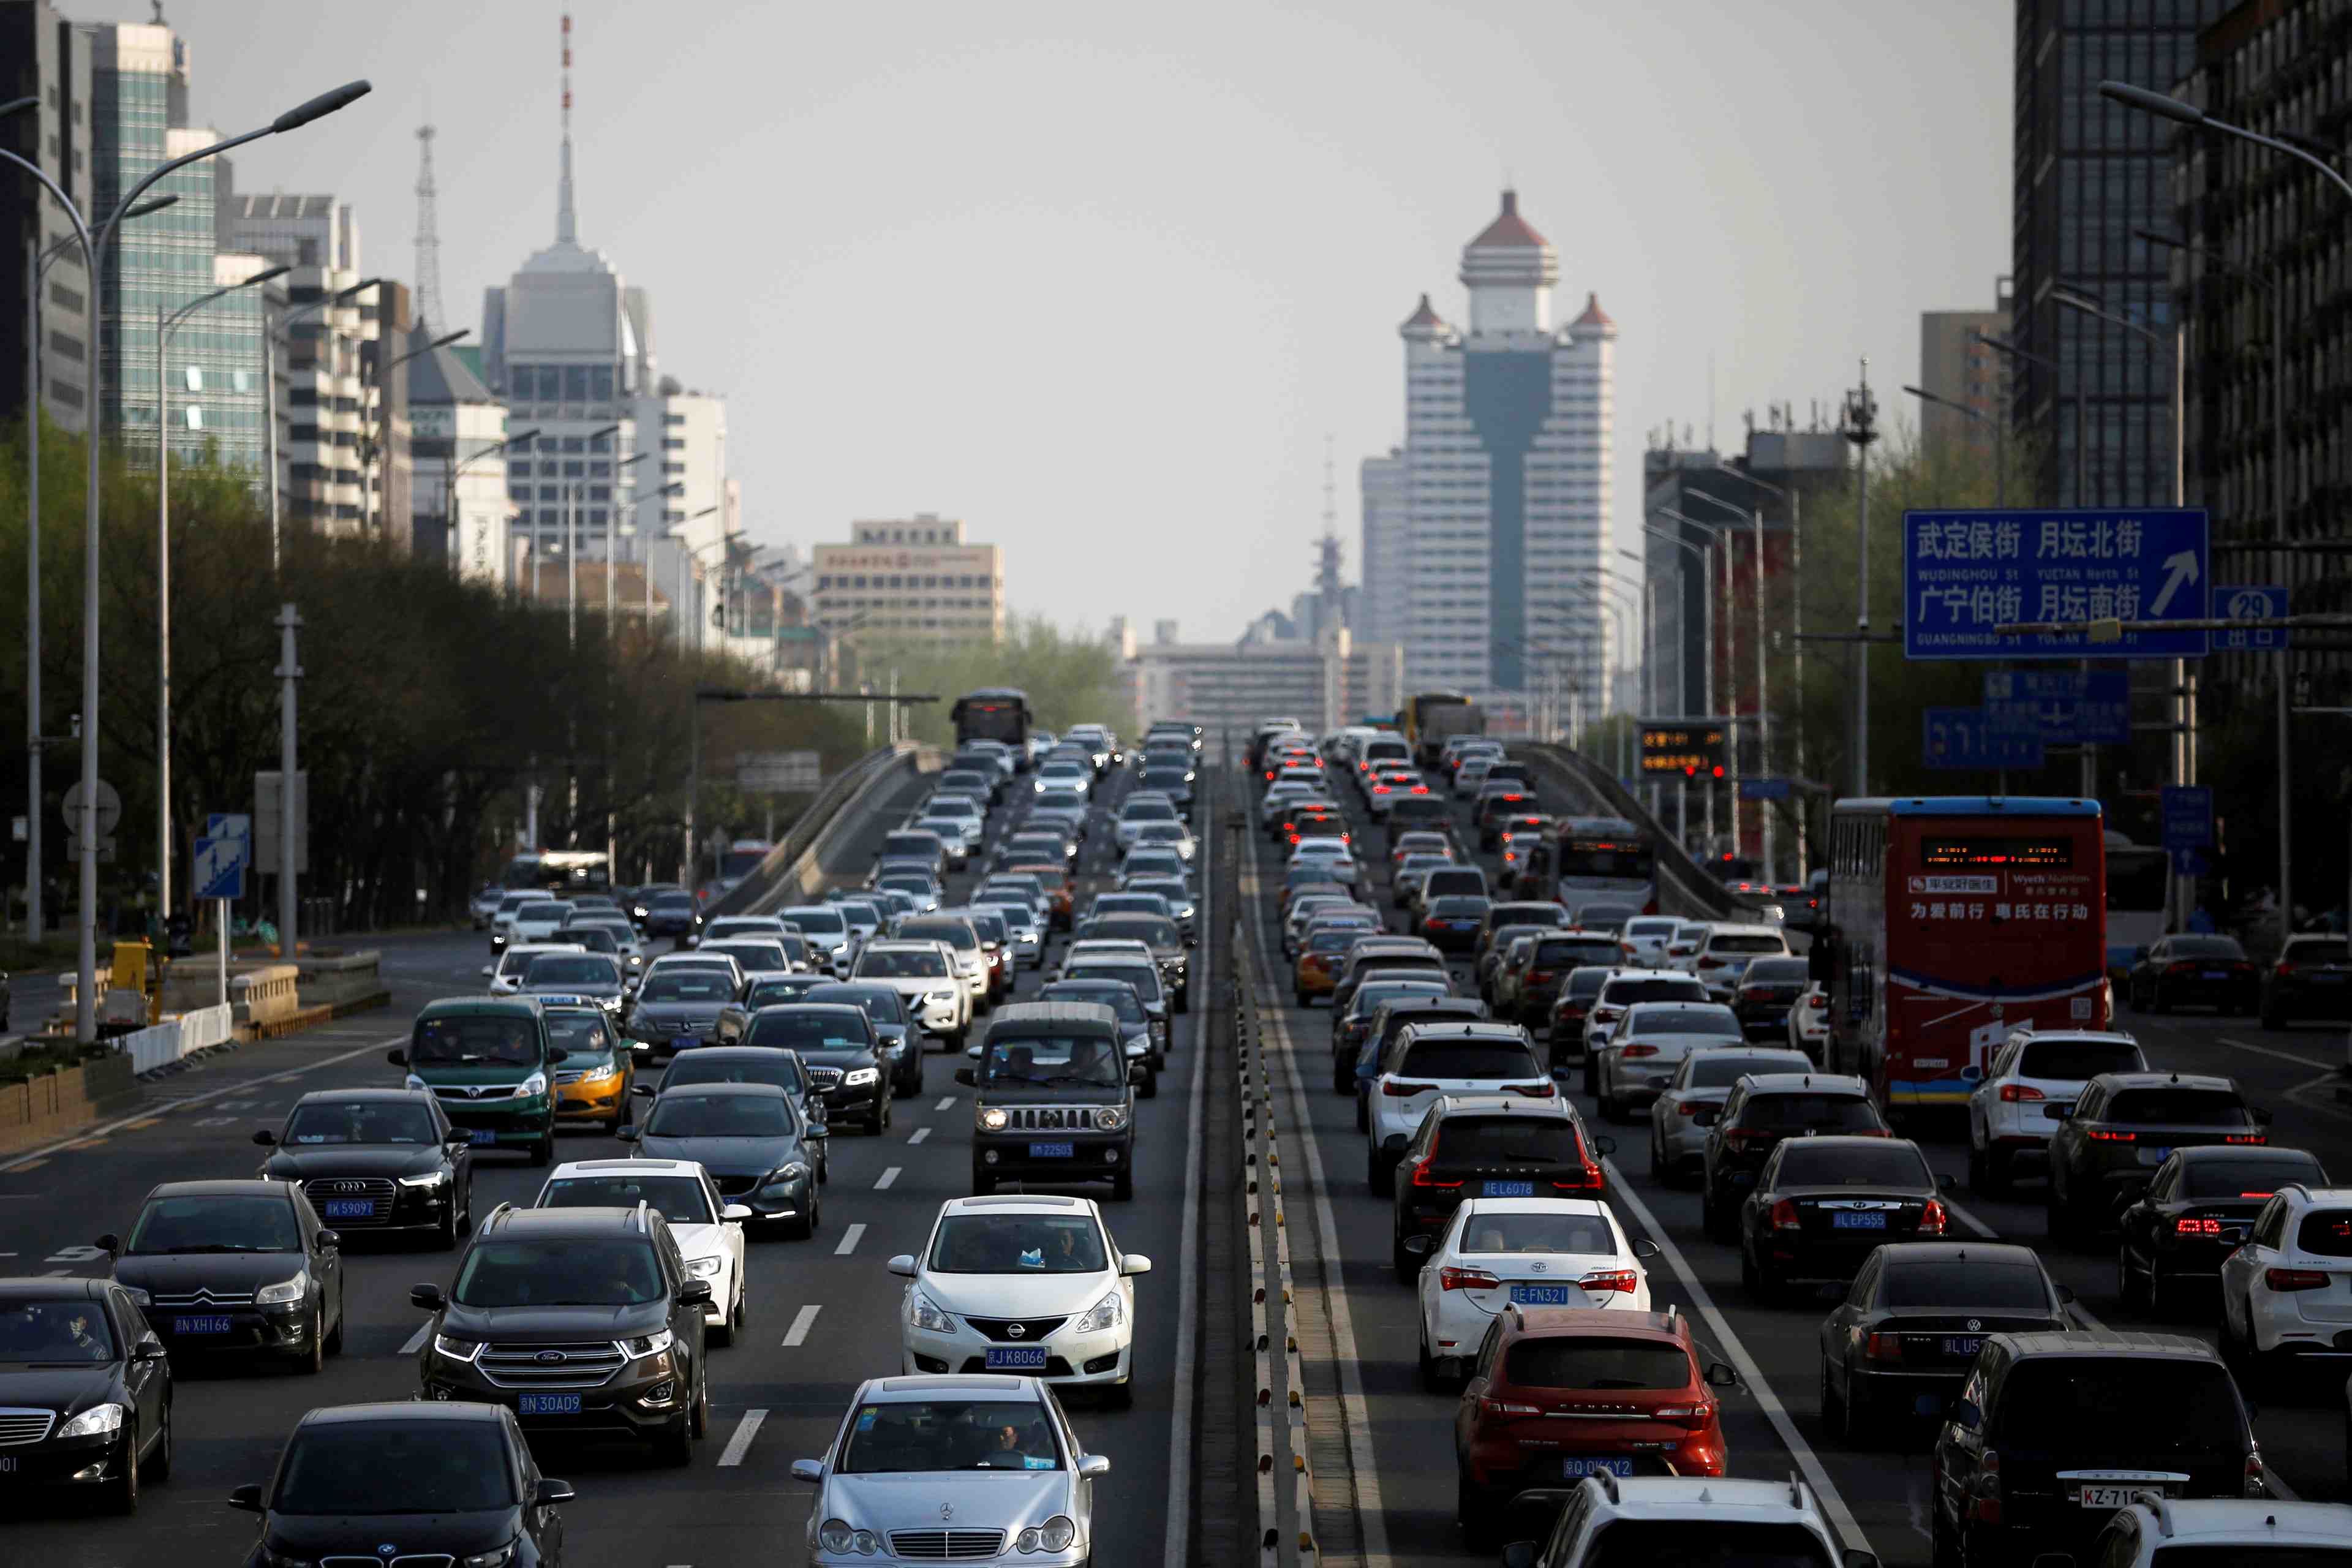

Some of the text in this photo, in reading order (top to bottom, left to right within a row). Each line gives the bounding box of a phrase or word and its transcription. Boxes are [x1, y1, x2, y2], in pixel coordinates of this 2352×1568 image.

[1917, 520, 2022, 560] 武定侯街
[2036, 519, 2143, 559] 月坛北街
[1918, 568, 1998, 581] WUDINGHOU
[1917, 584, 2022, 624] 广宁伯街
[2037, 584, 2140, 621] 月坛南街
